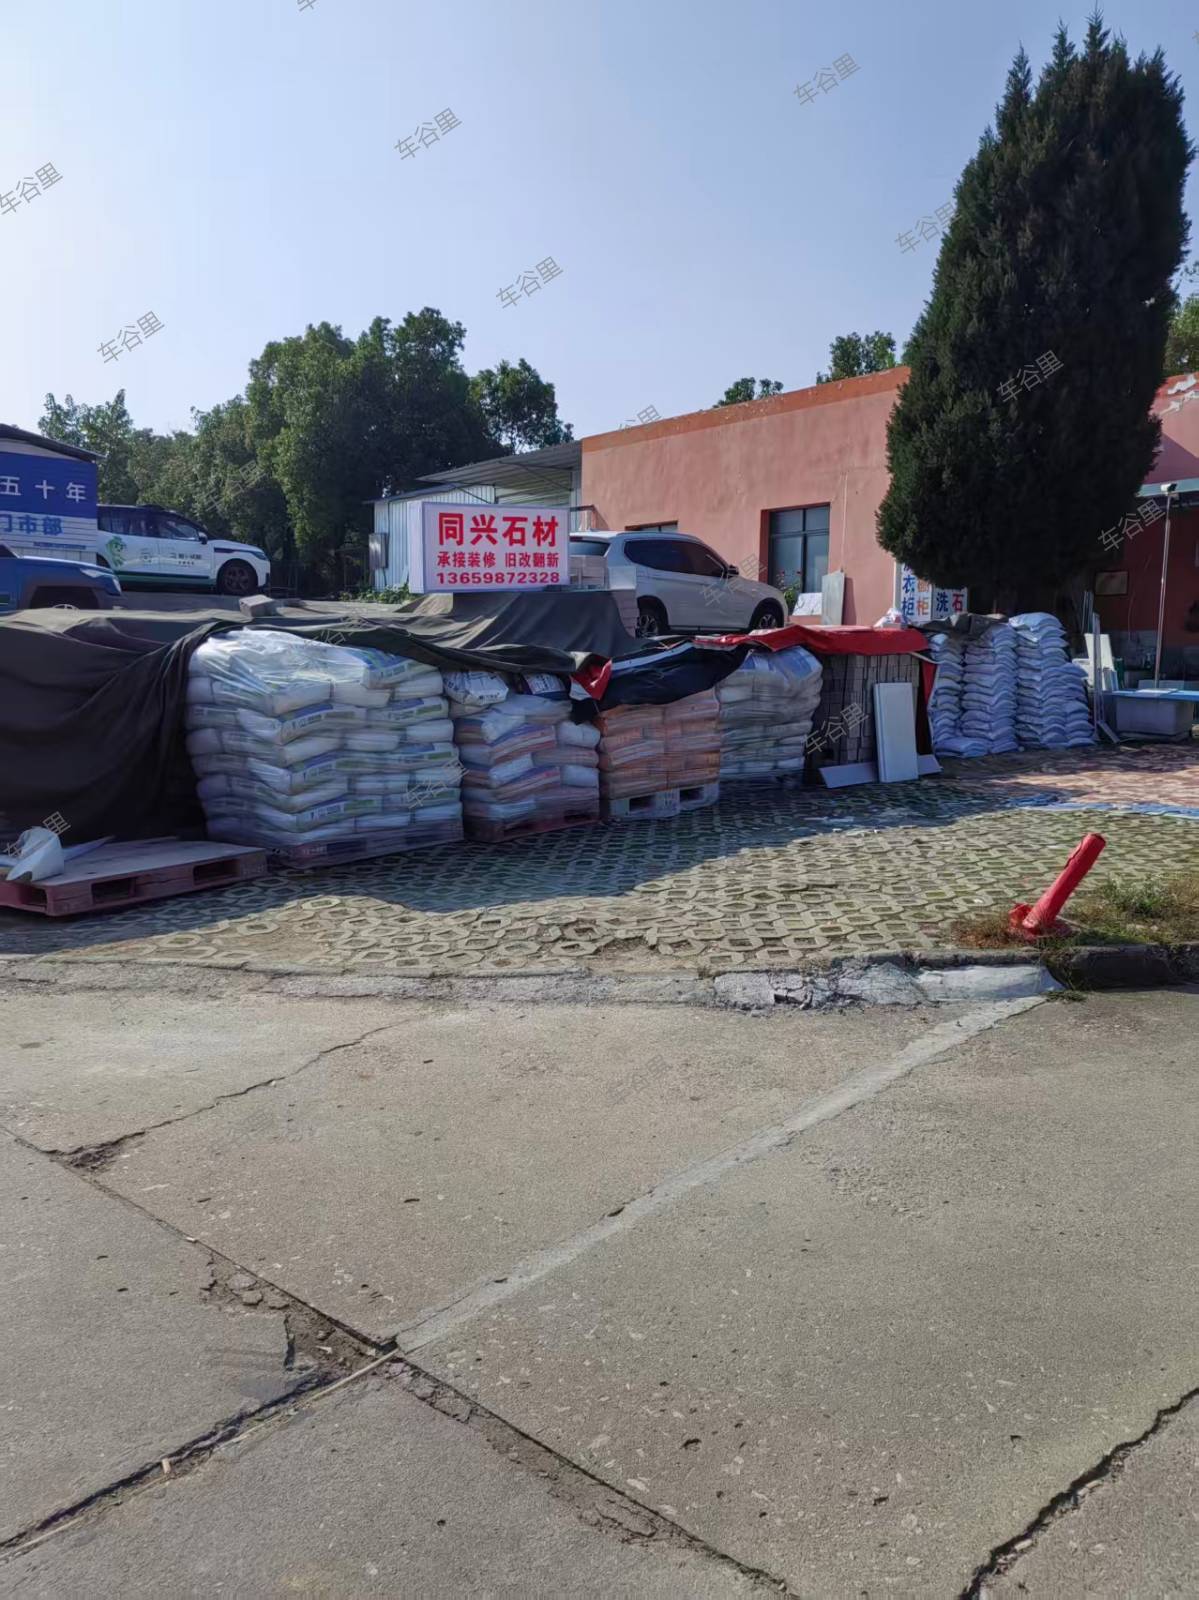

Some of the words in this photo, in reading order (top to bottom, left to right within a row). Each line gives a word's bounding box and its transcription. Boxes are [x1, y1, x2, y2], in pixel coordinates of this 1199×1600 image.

[0, 476, 87, 503] 五十年
[438, 512, 559, 547] 同兴石材
[437, 551, 497, 568] 承接装修
[505, 552, 560, 568] 旧改翻新
[436, 571, 560, 584] 13659872328
